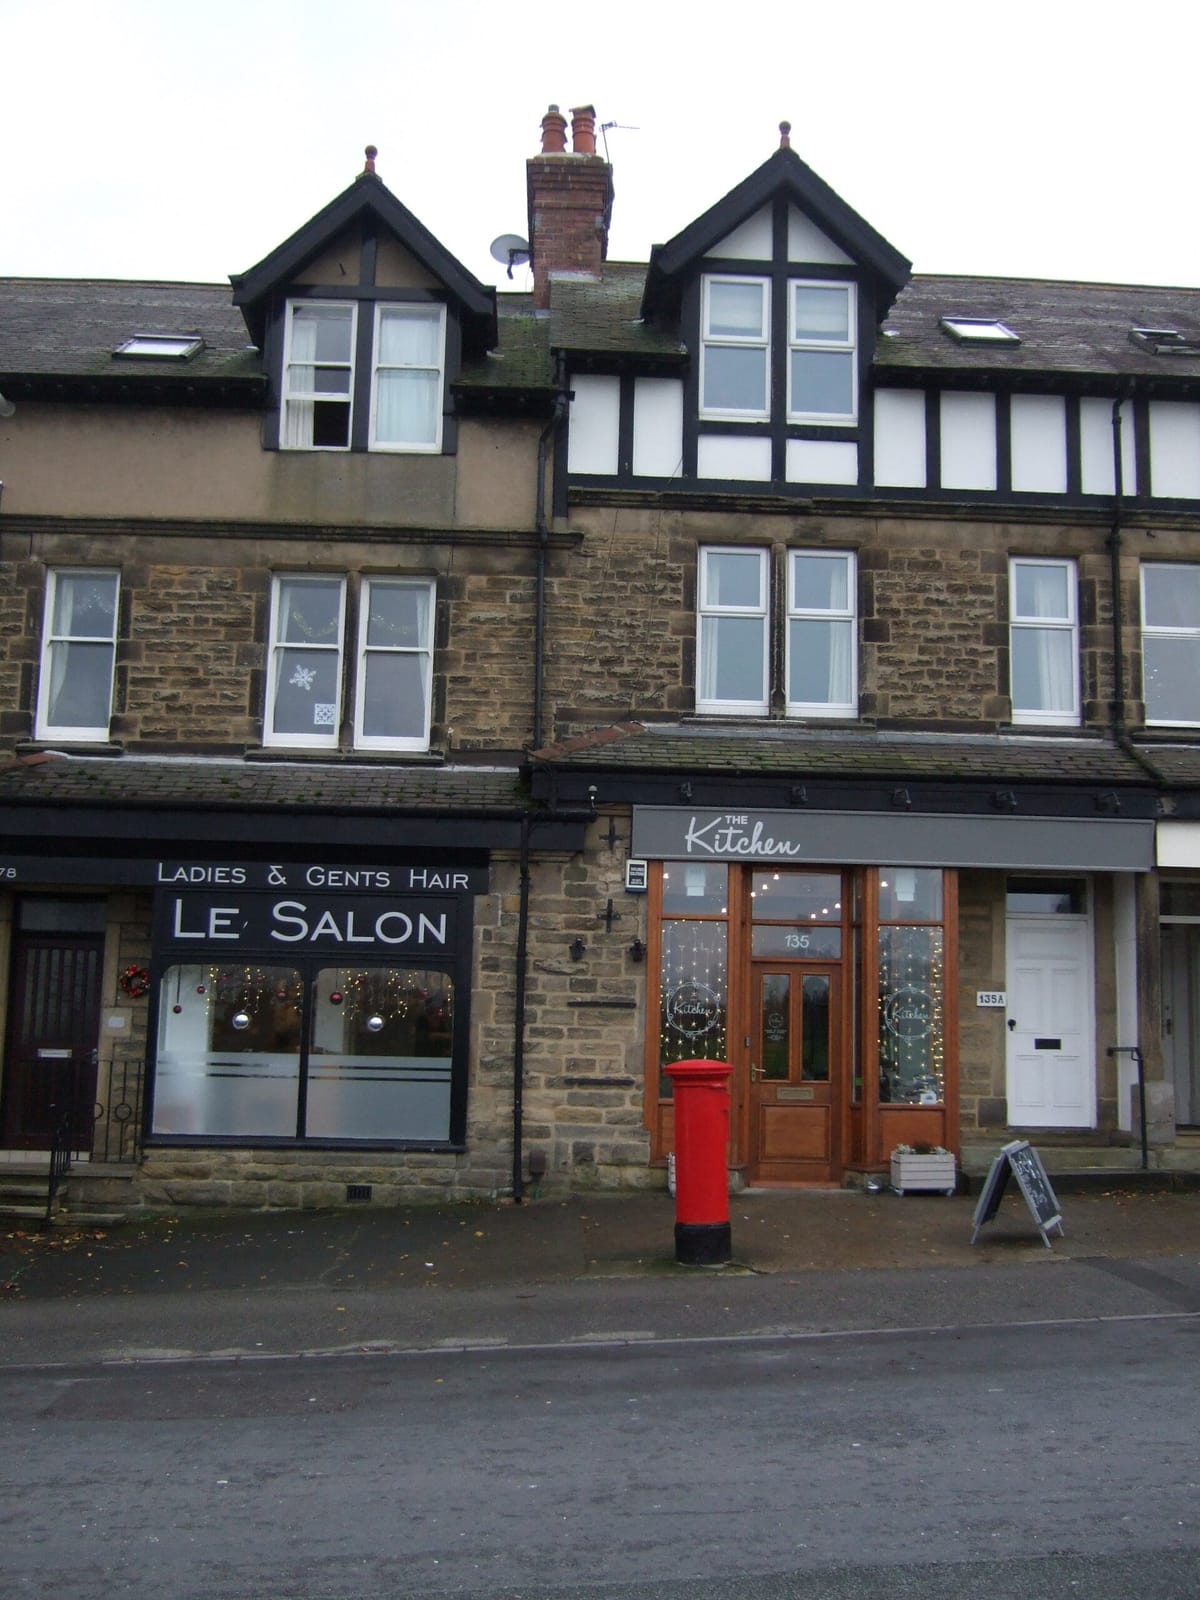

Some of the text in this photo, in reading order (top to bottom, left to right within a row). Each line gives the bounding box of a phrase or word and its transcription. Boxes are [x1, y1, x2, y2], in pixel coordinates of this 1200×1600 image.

[725, 815, 748, 825] THE
[684, 816, 800, 855] Kitchen
[157, 862, 469, 889] LADIES & GENTS HAIR
[270, 901, 447, 945] SALON
[784, 934, 809, 948] 135
[979, 994, 1005, 1004] 135A
[673, 1000, 713, 1015] Kitchen
